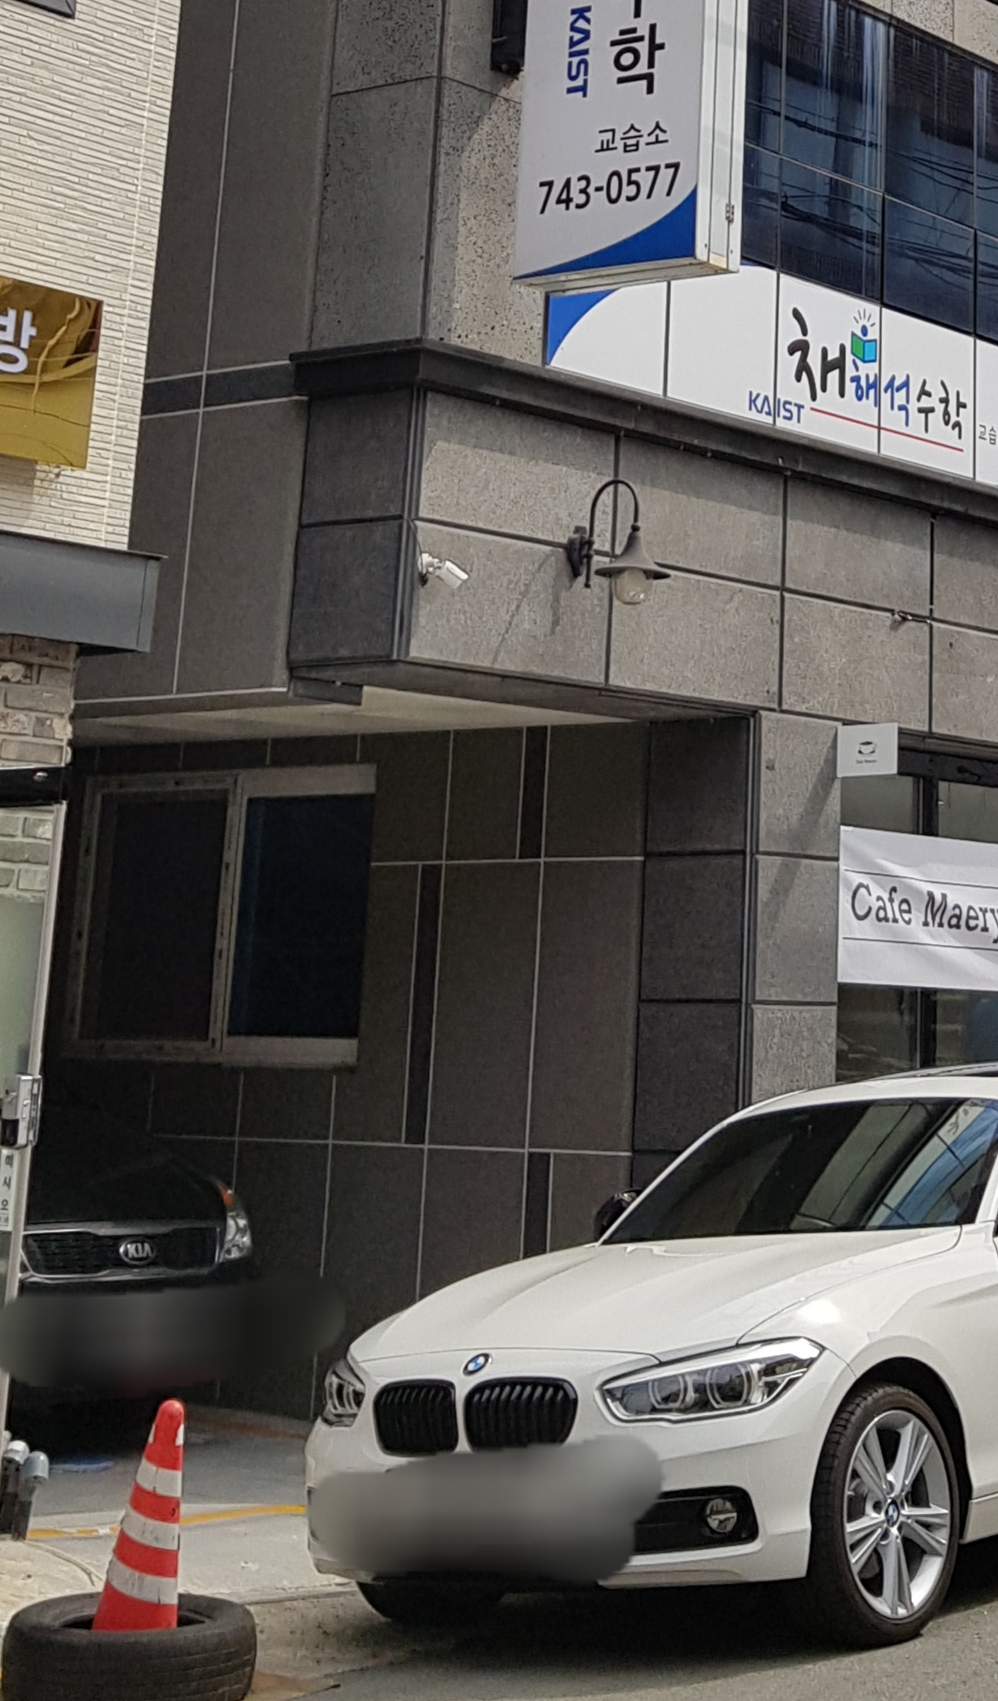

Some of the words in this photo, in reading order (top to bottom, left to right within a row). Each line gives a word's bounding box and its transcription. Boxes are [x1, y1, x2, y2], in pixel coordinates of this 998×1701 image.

[566, 5, 593, 98] KAIST
[594, 120, 669, 154] 교습소
[539, 161, 681, 215] 743-0577
[748, 389, 805, 424] KAIST
[850, 882, 913, 926] Cafe
